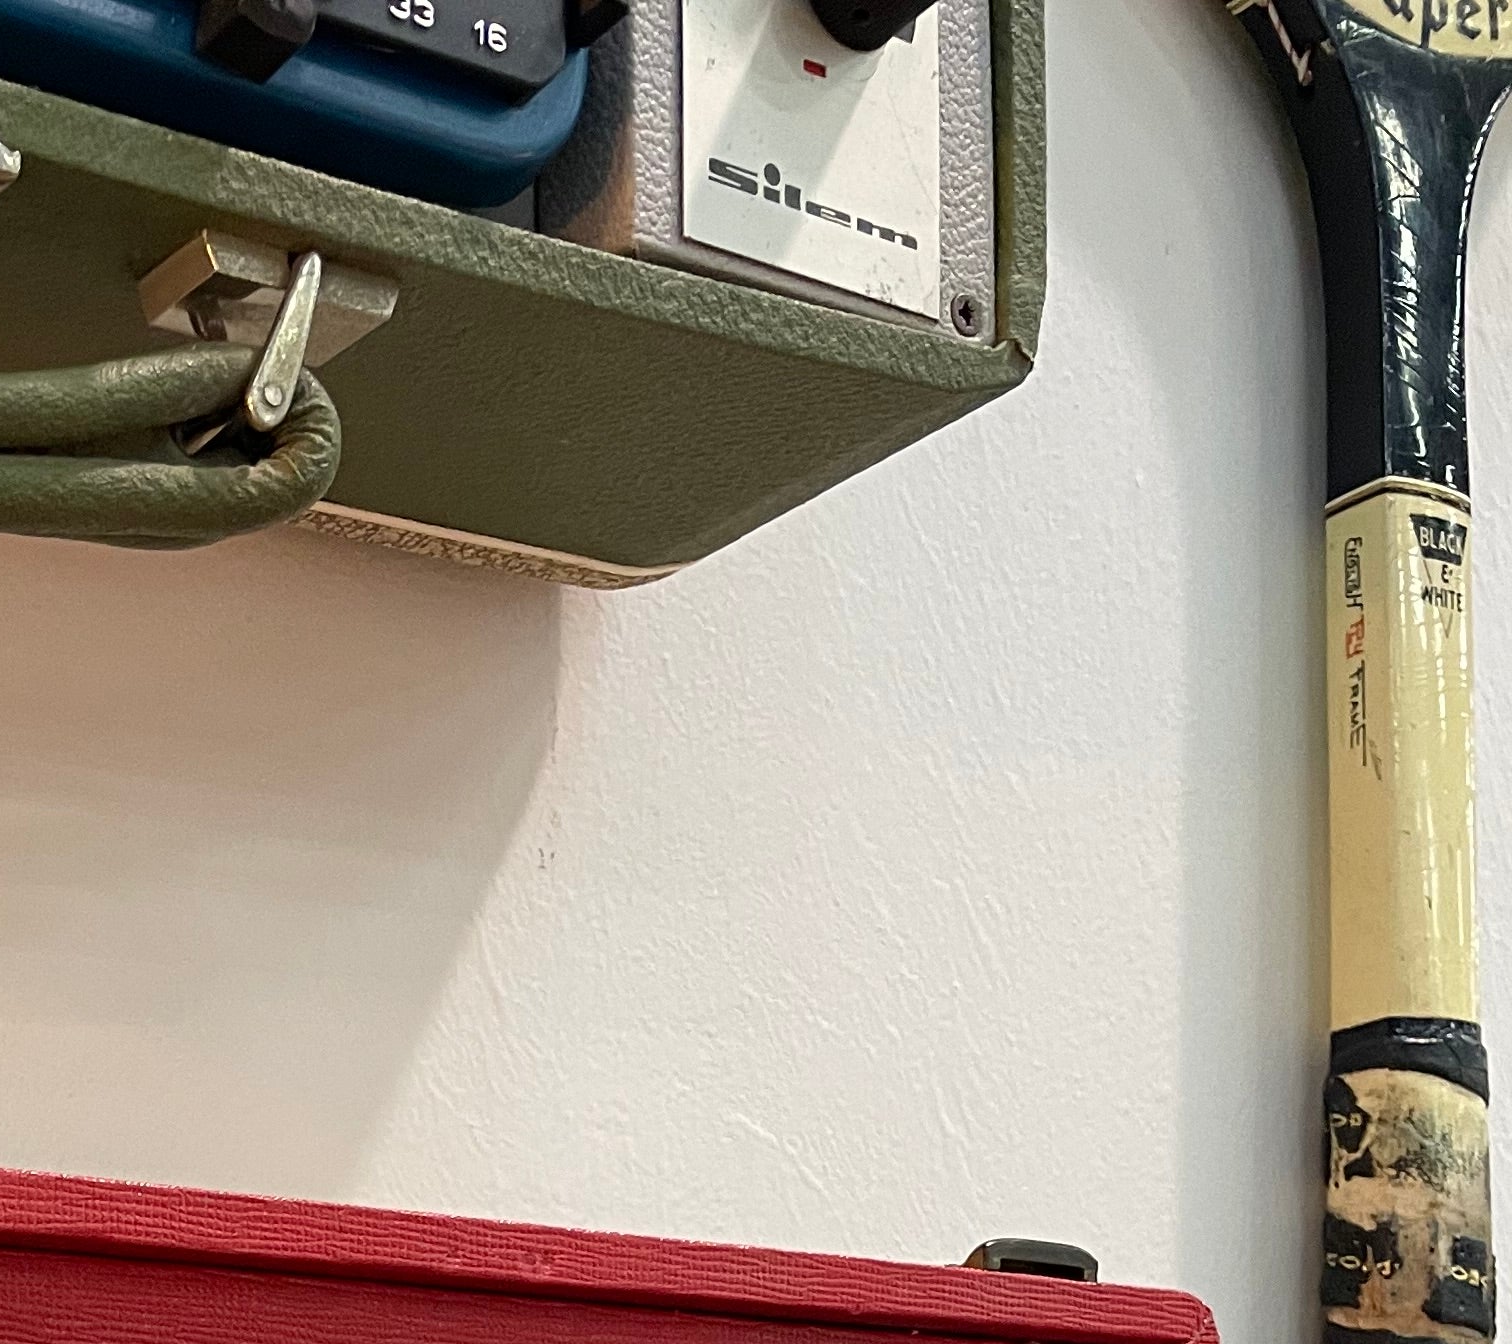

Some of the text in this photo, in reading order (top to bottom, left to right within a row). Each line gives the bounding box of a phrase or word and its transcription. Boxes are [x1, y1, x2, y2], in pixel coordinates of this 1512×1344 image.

[474, 19, 507, 52] 16
[1419, 526, 1466, 558] BLACK
[1420, 584, 1464, 612] WHITE
